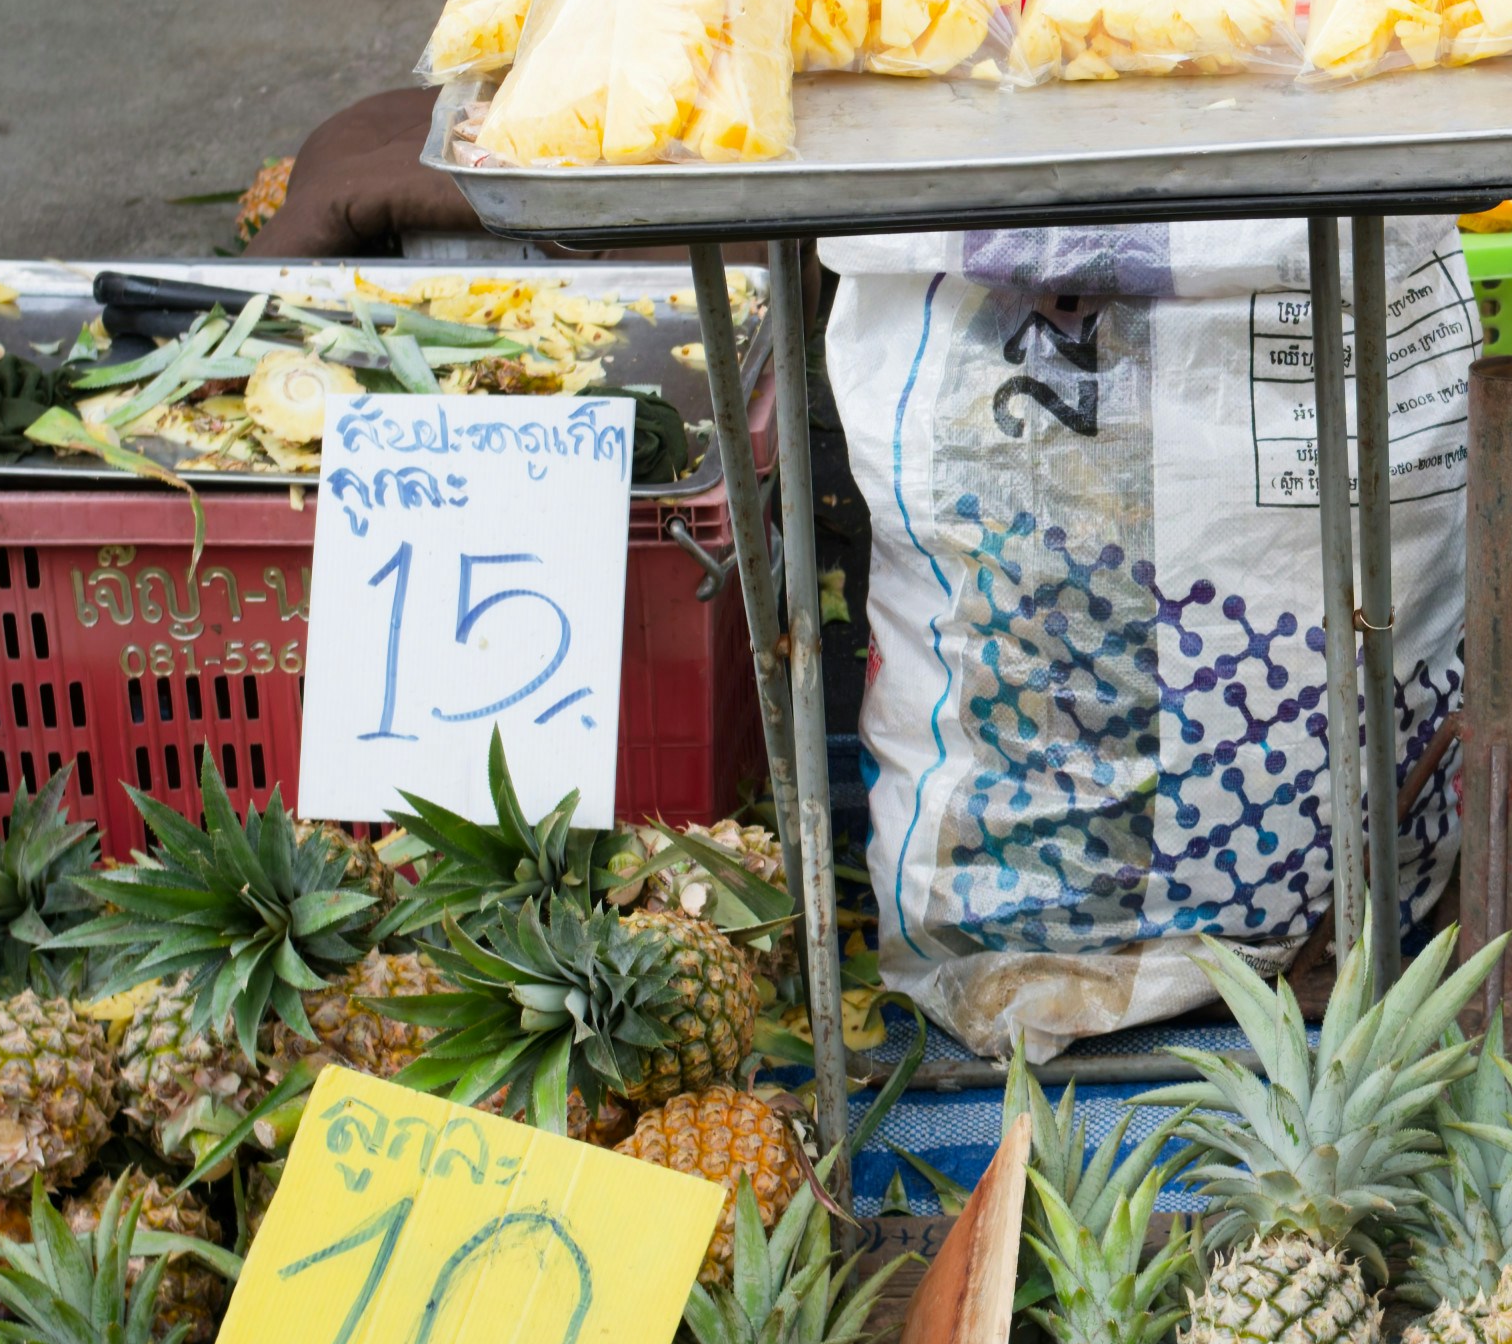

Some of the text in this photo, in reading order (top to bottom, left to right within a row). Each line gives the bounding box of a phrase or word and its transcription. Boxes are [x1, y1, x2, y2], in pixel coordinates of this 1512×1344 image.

[327, 466, 469, 537] ลูกละ
[119, 639, 304, 678] 081-536
[319, 1096, 526, 1193] ลูกละ
